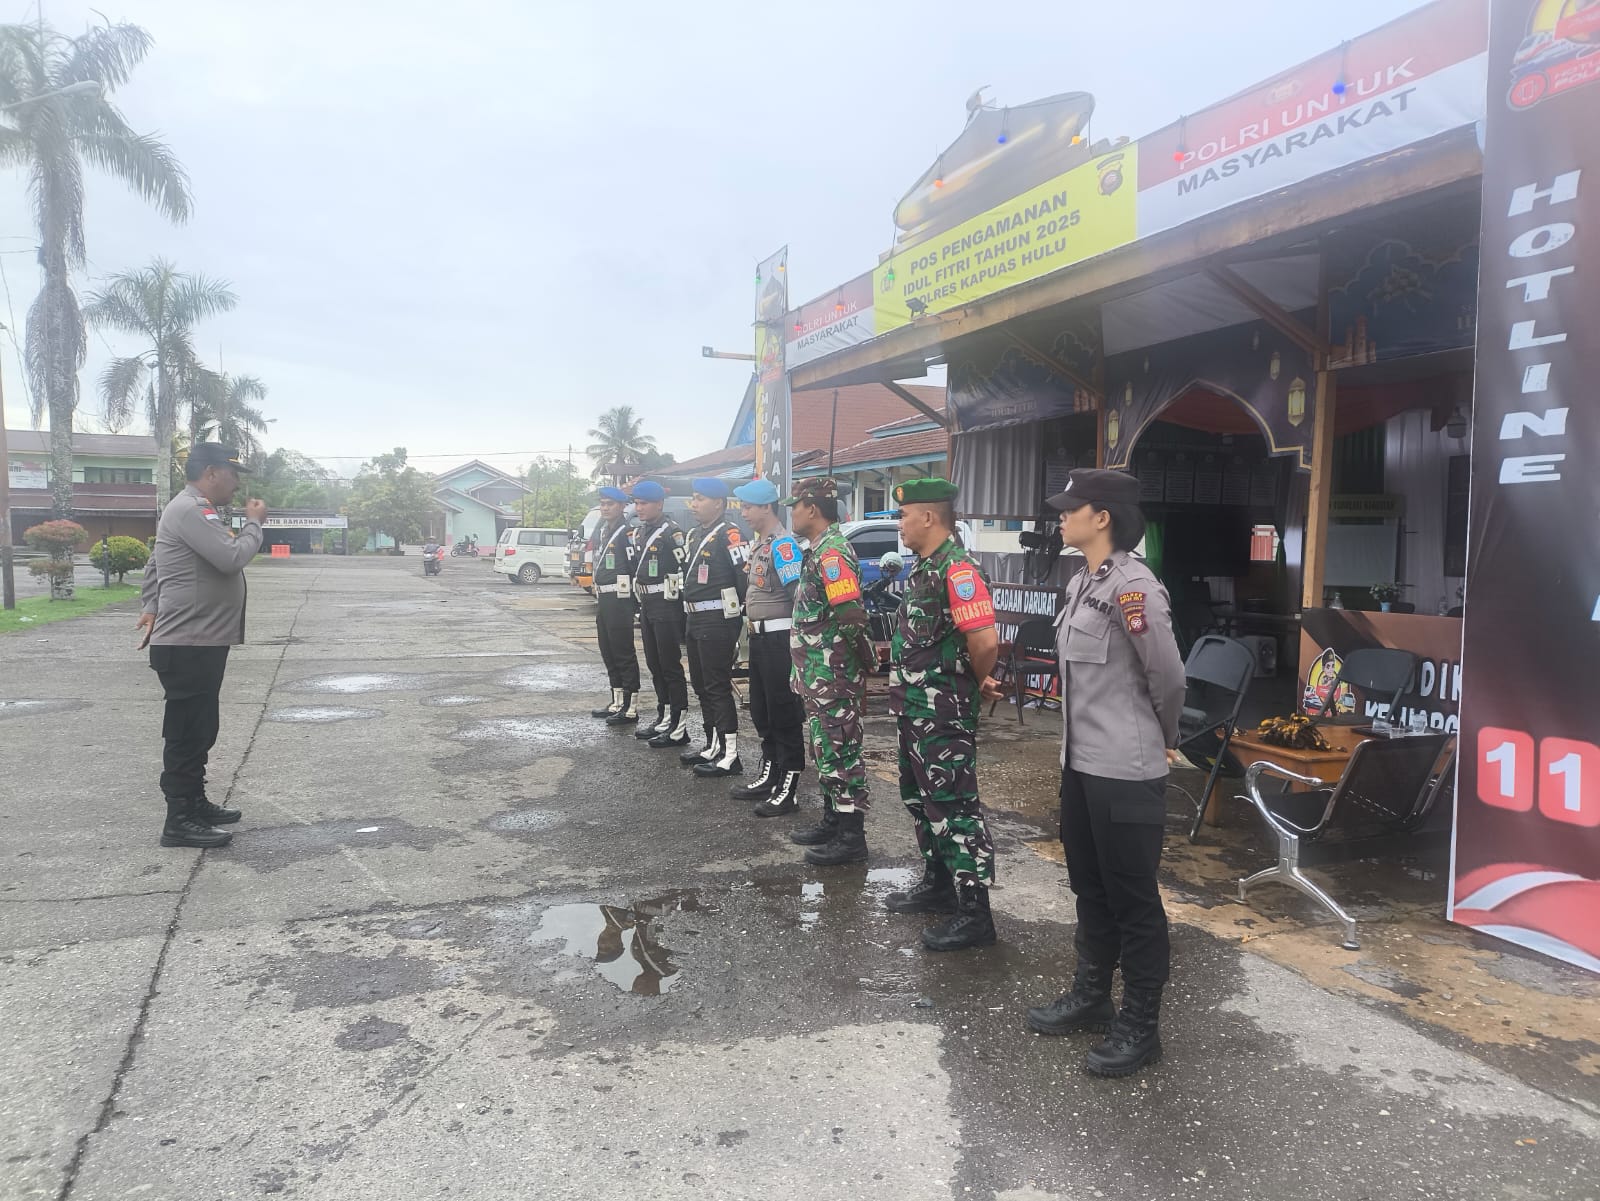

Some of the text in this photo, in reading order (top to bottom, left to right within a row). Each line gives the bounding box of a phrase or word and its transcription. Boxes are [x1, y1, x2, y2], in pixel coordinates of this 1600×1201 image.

[1177, 87, 1417, 196] MASYARAKAT
[1179, 57, 1415, 170] POLRI UNTUK
[903, 209, 1081, 297] IDUL FITRI TAHUN 2025
[910, 190, 1068, 275] POS PENGAMANAN
[917, 238, 1067, 305] OLRES KAPUAS HULU
[796, 315, 859, 350] MASYARAKAT
[1499, 169, 1581, 484] HOTLINE
[992, 587, 1058, 617] KEADAAN DARURAT
[1082, 596, 1114, 616] POLRI
